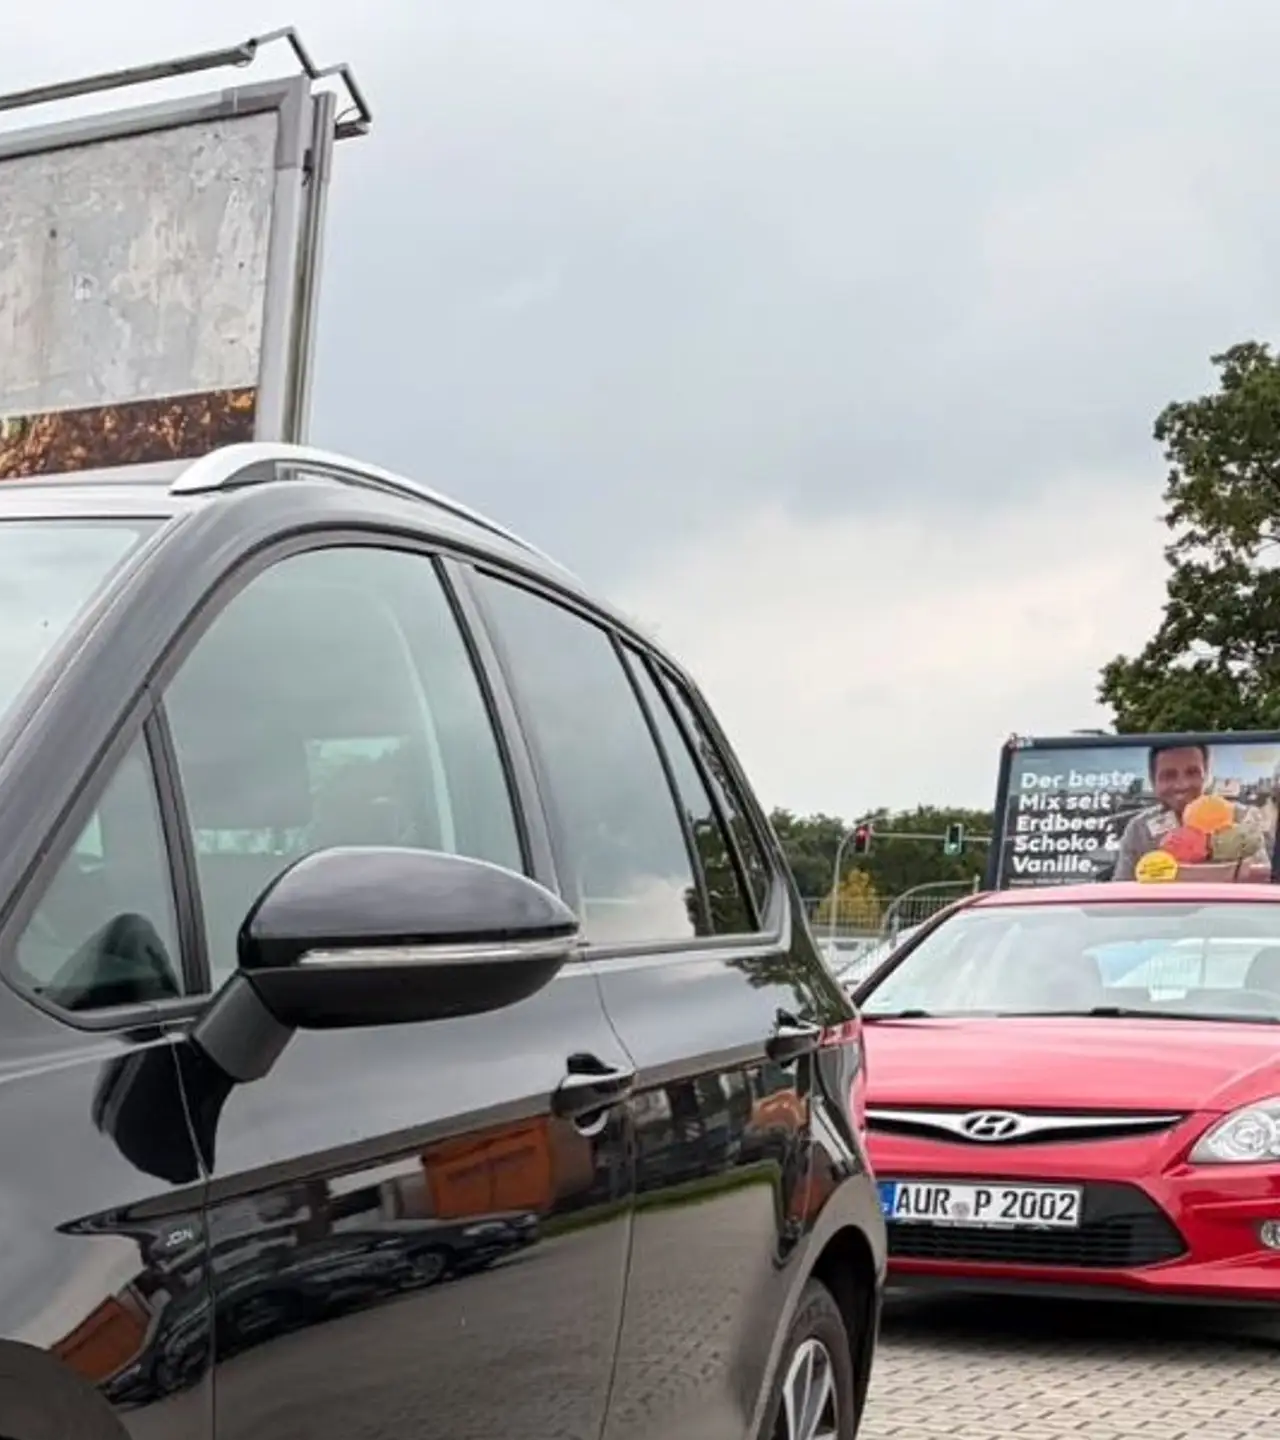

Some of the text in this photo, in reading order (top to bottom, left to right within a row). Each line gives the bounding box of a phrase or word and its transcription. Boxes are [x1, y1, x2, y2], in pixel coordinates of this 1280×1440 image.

[1021, 770, 1136, 789] Der beste
[1019, 790, 1112, 811] Mix seit
[1016, 814, 1114, 832] Erdbeer,
[1013, 834, 1099, 852] Schoko
[1012, 855, 1099, 873] Vanille.
[896, 1186, 1077, 1221] AUR P 2002
